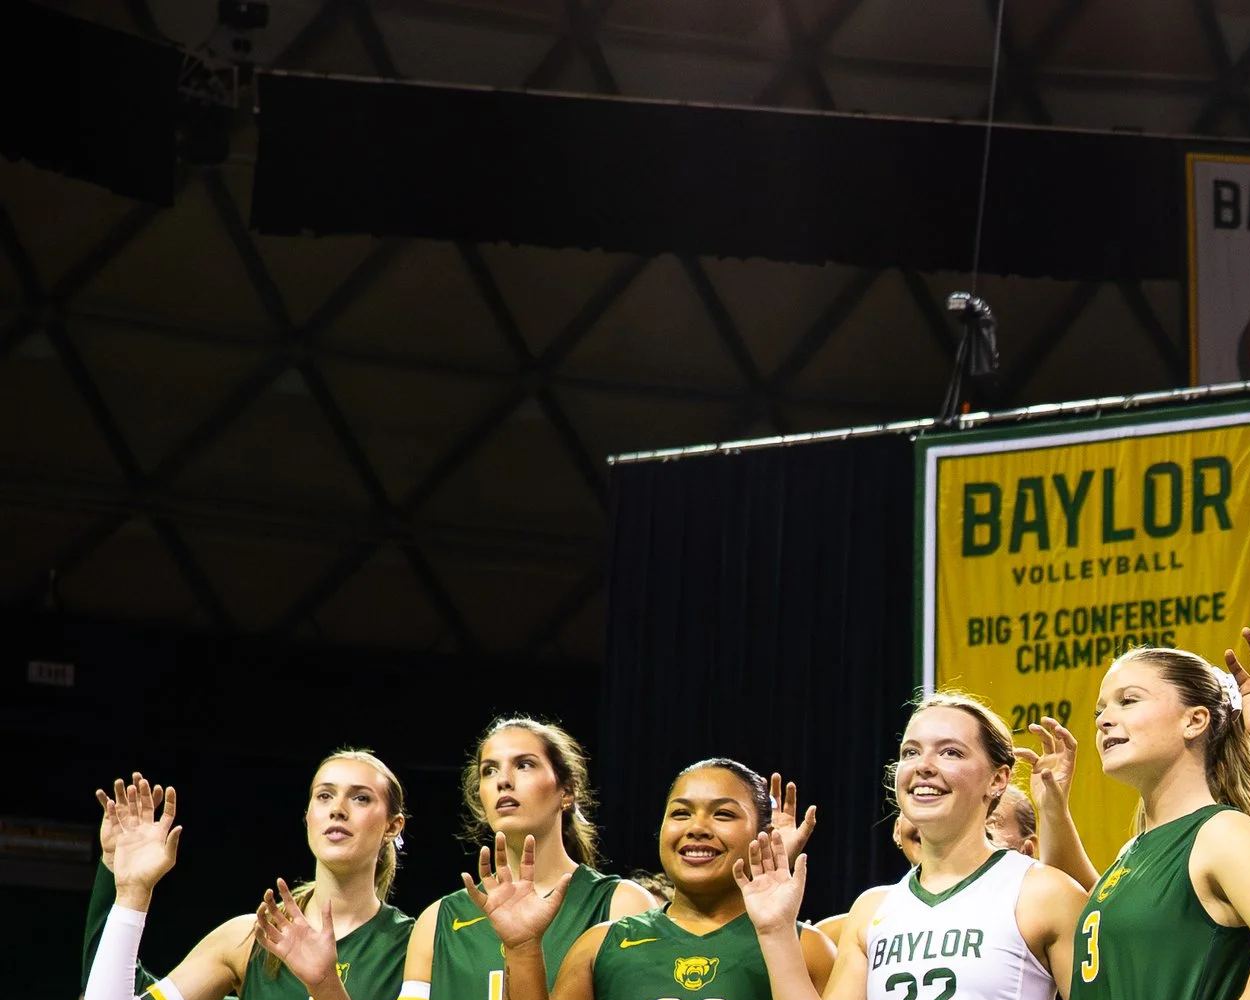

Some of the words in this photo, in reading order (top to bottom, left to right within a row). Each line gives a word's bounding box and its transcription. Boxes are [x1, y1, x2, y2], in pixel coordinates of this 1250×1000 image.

[962, 456, 1233, 557] BAYLOR
[1012, 551, 1183, 586] VOLLEYBALL
[968, 614, 1012, 646] BIG
[1020, 611, 1046, 641] 12
[1054, 592, 1226, 638] CONFERENCE
[872, 928, 984, 970] BAYLOR
[1081, 910, 1101, 983] 3
